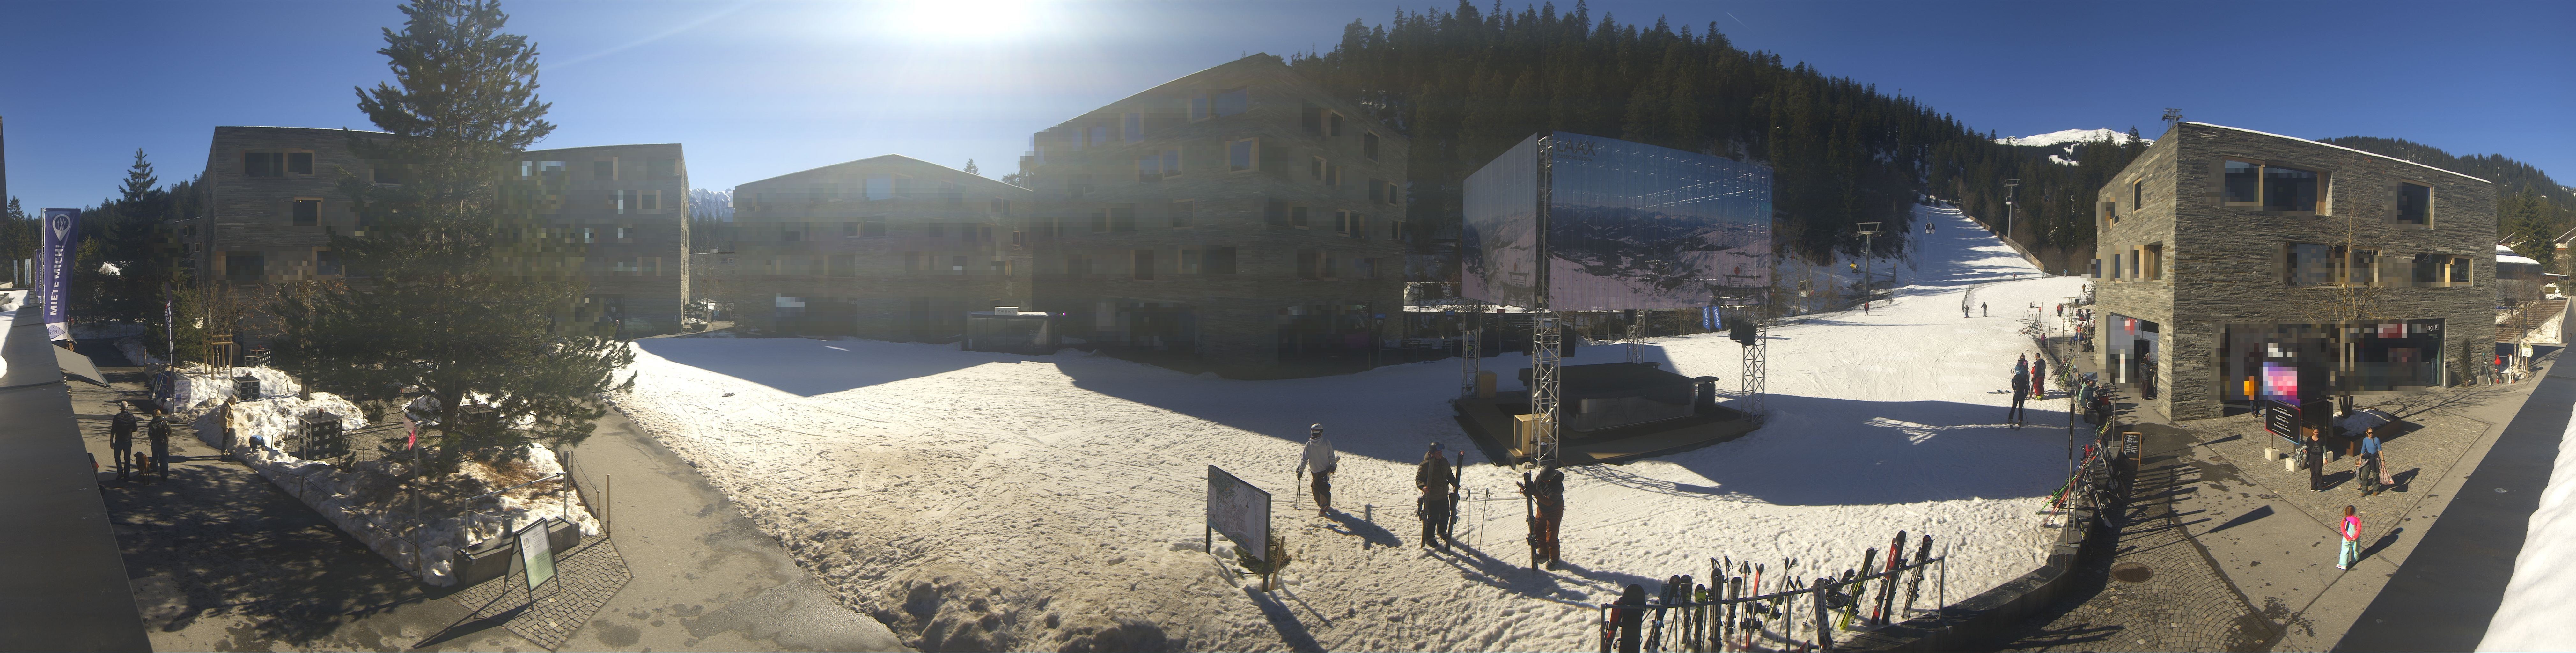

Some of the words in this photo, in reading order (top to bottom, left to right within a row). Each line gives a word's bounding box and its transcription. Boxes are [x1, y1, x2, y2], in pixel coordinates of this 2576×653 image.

[1557, 138, 1595, 156] LAAX
[54, 245, 64, 279] MICH!
[50, 282, 60, 315] MIETE
